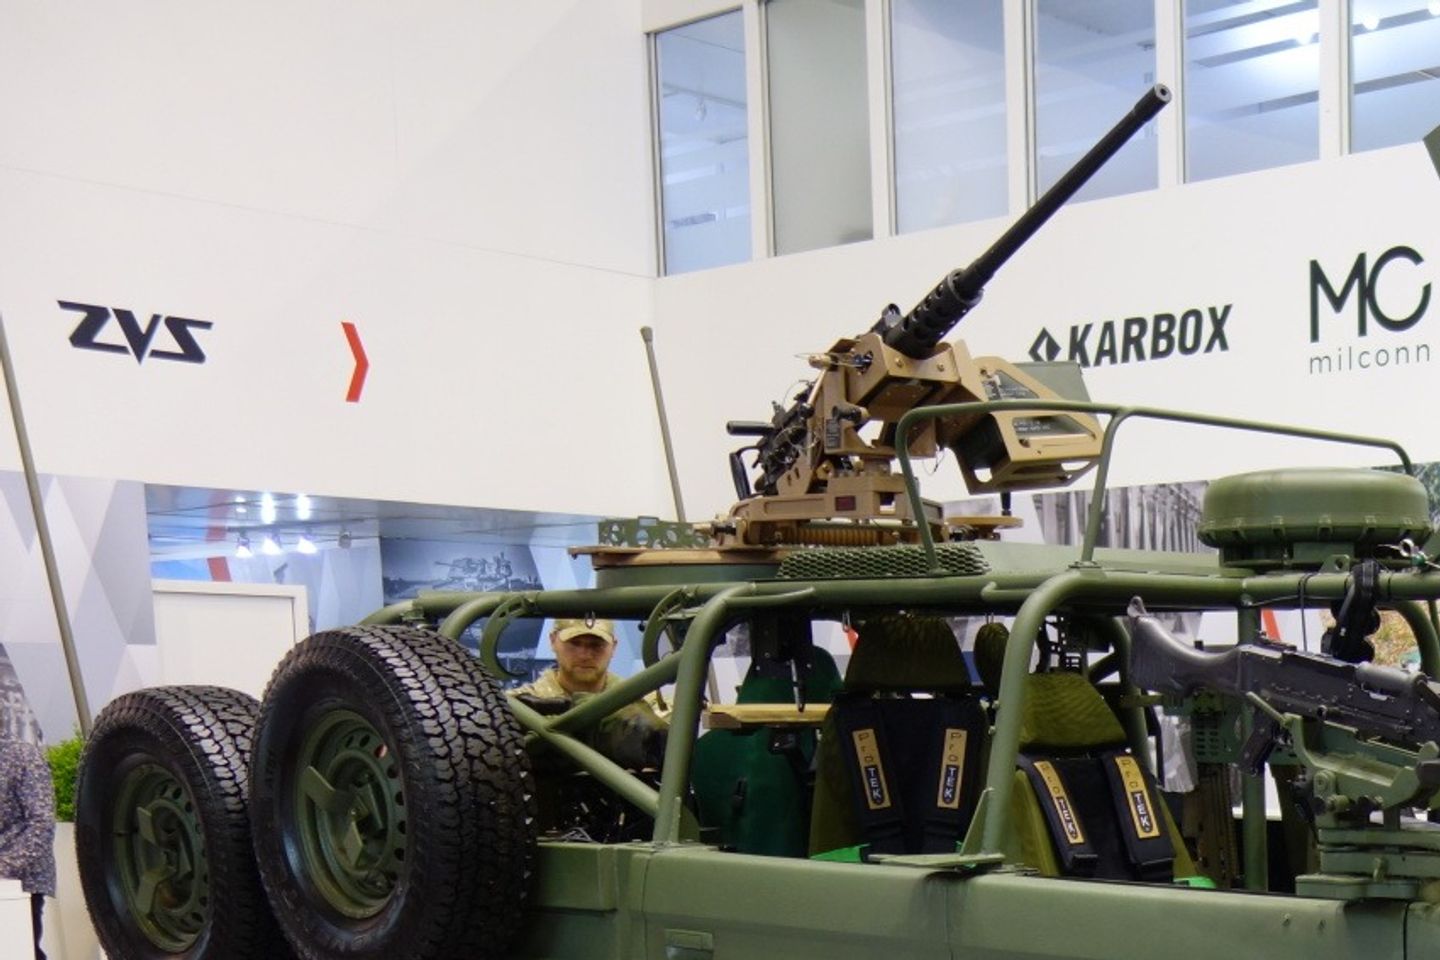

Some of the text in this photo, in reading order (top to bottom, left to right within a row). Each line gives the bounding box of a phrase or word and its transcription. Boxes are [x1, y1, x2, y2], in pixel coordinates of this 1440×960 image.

[1309, 245, 1432, 343] MC
[57, 300, 214, 366] ZVS
[1067, 304, 1233, 369] KARBOX
[1309, 344, 1430, 374] milconn
